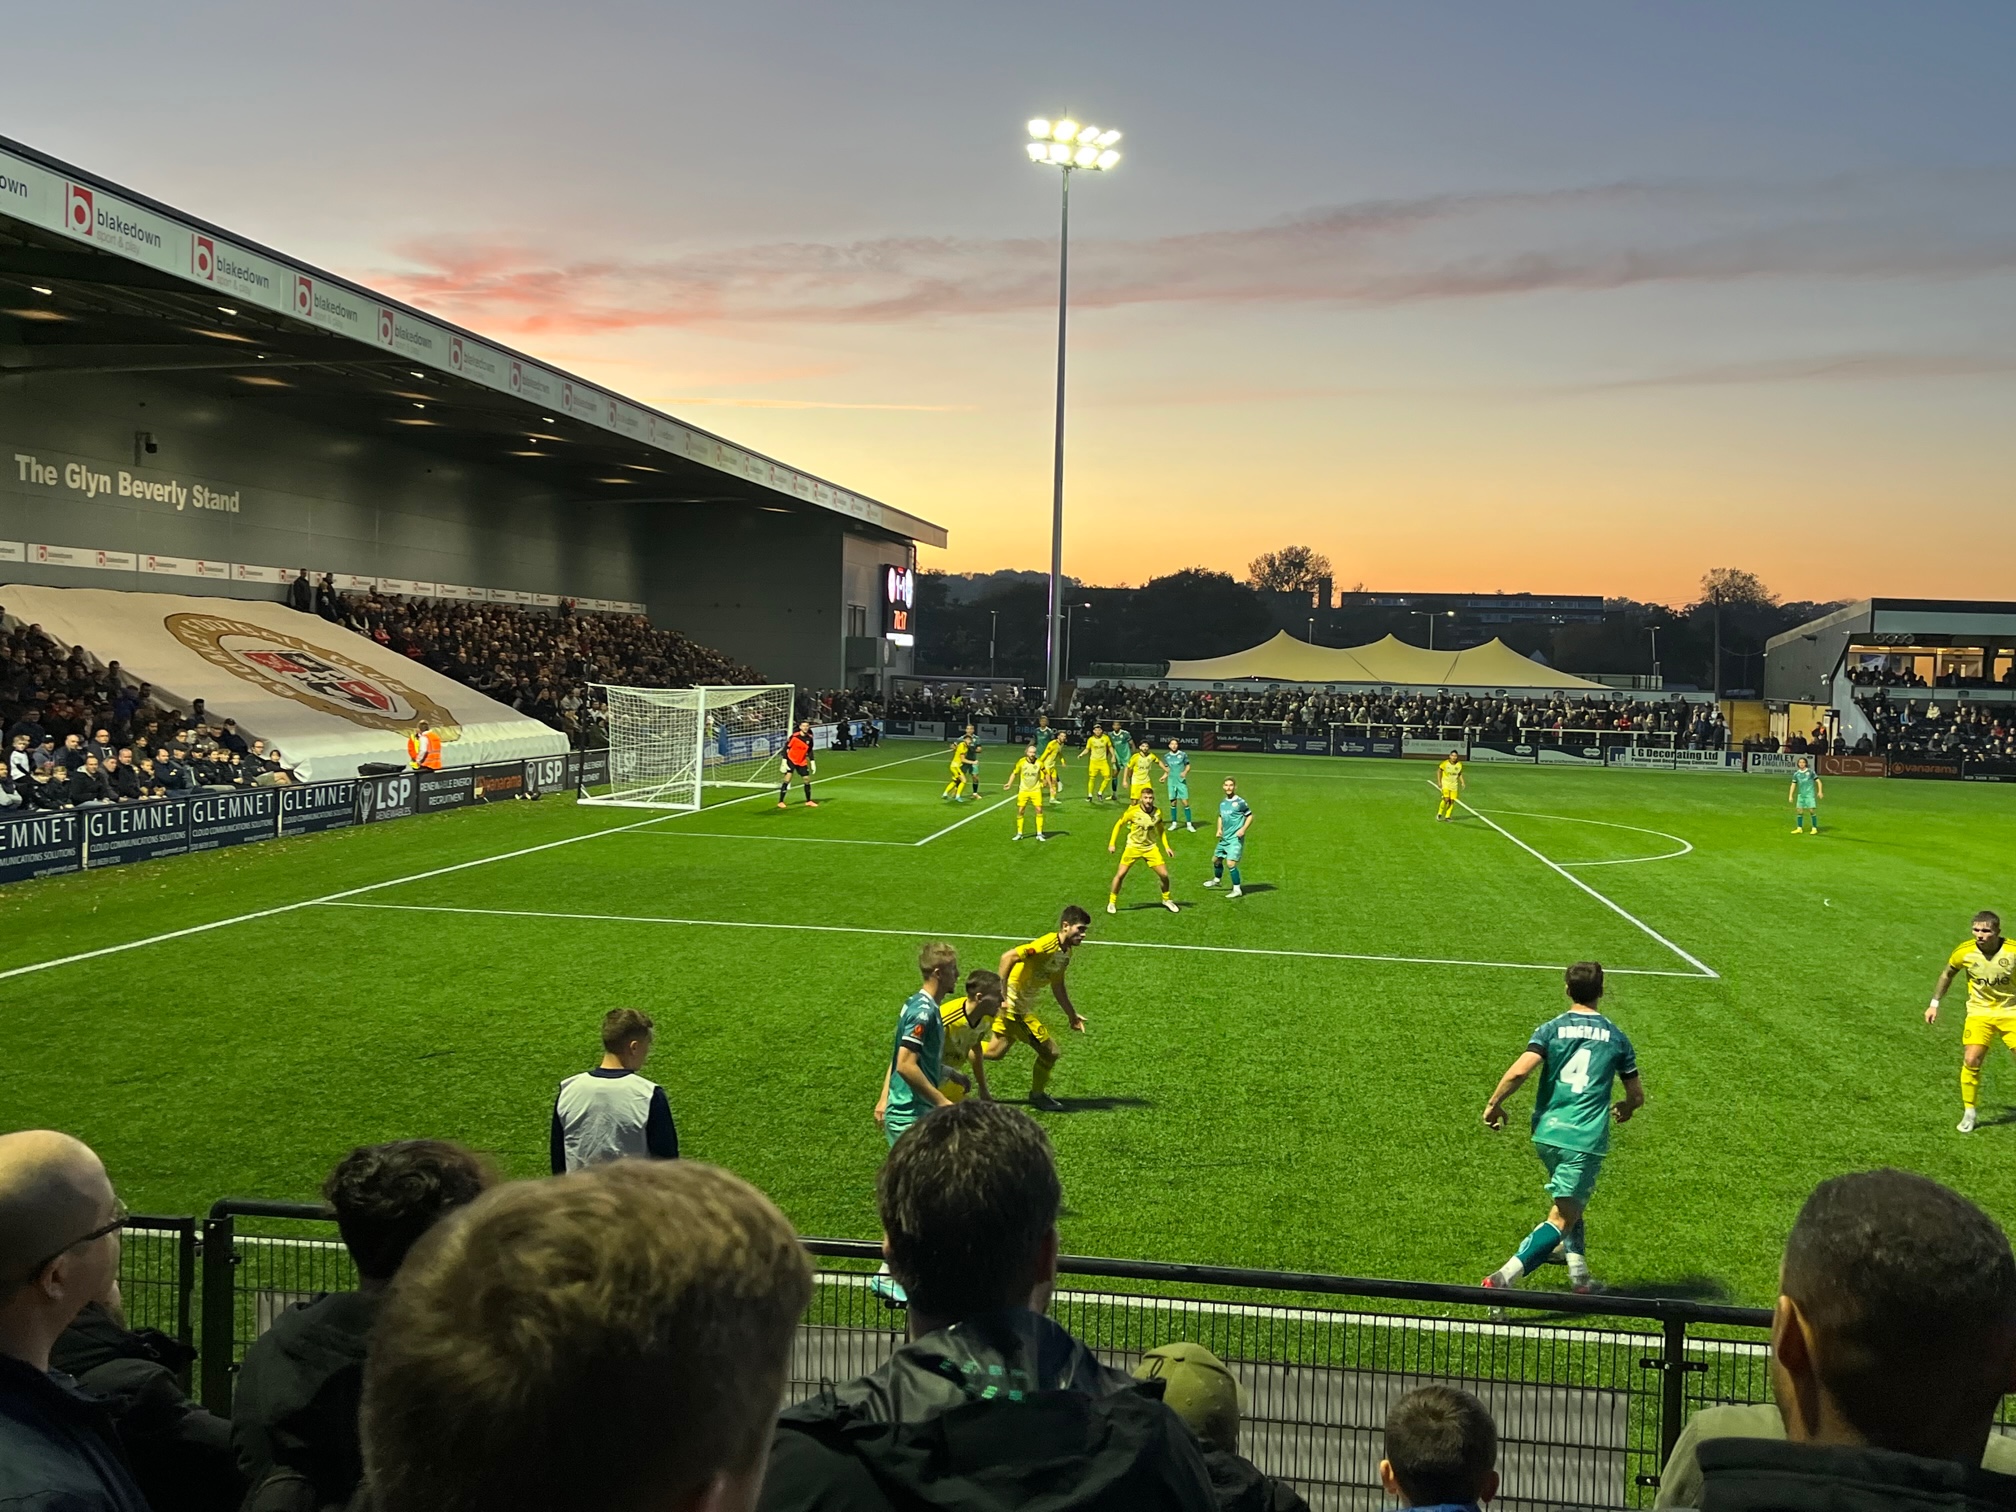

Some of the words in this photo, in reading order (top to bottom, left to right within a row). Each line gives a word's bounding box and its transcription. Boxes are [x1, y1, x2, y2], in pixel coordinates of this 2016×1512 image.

[97, 208, 161, 248] blakedown
[216, 255, 270, 289] blakedown
[314, 293, 358, 322] blakedown
[395, 324, 432, 349] blakedown
[15, 454, 58, 486] The
[65, 463, 111, 498] Glyn
[118, 471, 188, 511] Beverly
[192, 485, 240, 513] Stand
[1704, 752, 1718, 760] Ltd
[1905, 763, 1958, 774] vanarama
[538, 760, 562, 785] LSP
[193, 793, 273, 823] GLEMNET
[283, 784, 356, 811] GLEMNET
[376, 778, 411, 809] LSP
[90, 803, 186, 837] GLEMNET
[1560, 1048, 1592, 1094] 4
